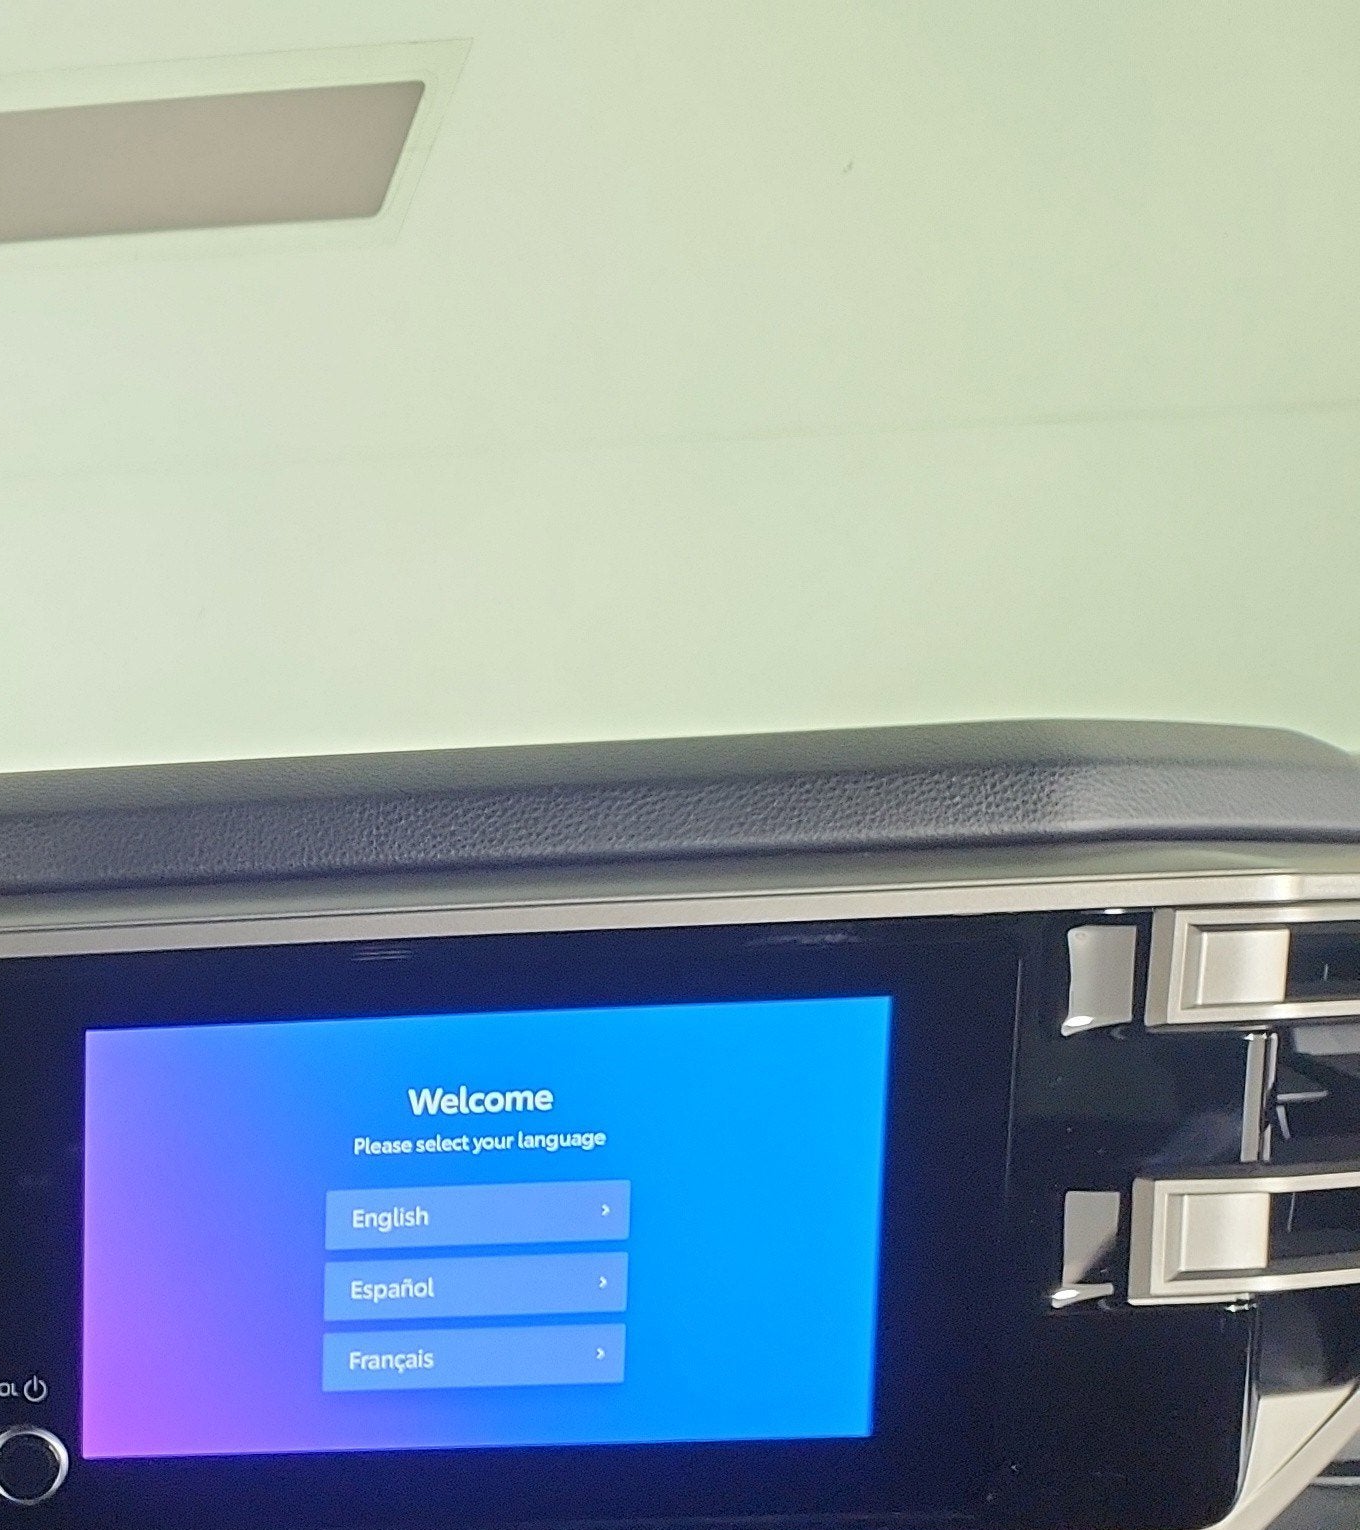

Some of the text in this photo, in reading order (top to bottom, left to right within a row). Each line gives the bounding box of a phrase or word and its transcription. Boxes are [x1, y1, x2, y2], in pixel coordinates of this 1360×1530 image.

[407, 1085, 555, 1116] Welcome
[353, 1131, 608, 1156] Please select your language
[351, 1206, 430, 1233] English
[350, 1277, 435, 1304] Español
[348, 1348, 435, 1374] Français
